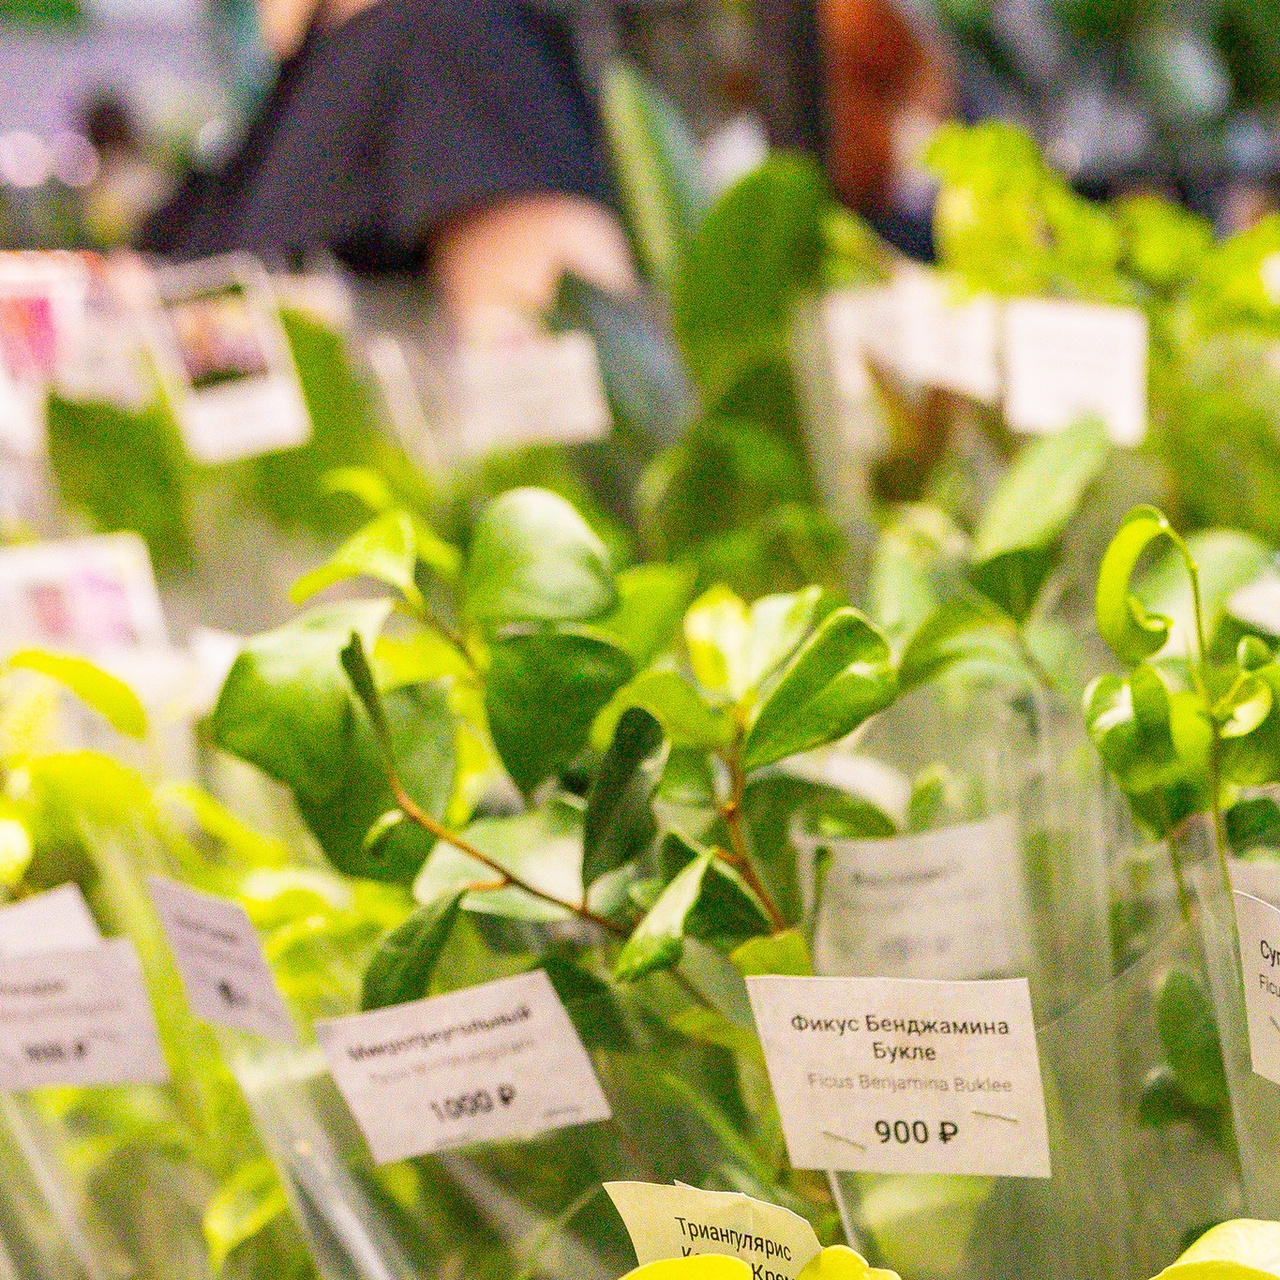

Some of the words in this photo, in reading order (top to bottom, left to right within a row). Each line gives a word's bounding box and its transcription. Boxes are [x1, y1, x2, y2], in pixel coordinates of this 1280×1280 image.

[791, 1015, 859, 1036] Фикус
[865, 1014, 1010, 1036] Бенджамина
[872, 1041, 936, 1063] Букле
[874, 1120, 929, 1144] 900
[674, 1216, 792, 1262] Триангулярис
